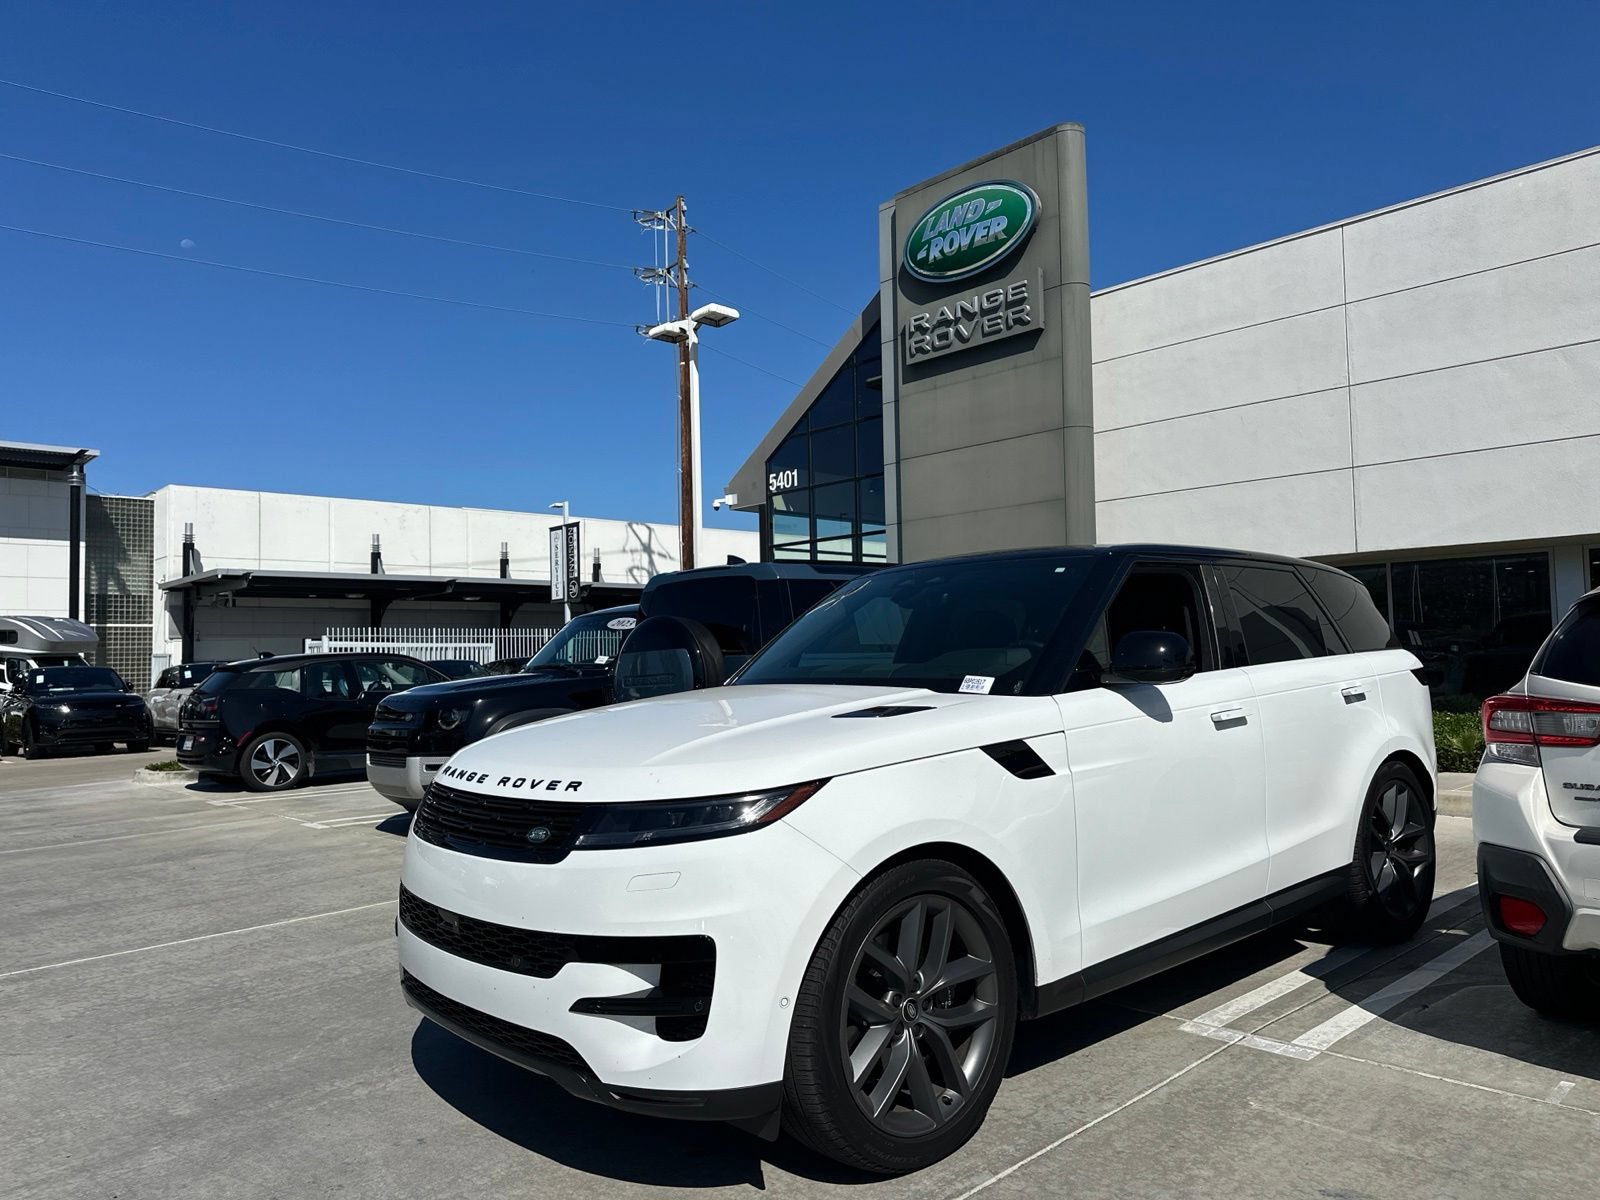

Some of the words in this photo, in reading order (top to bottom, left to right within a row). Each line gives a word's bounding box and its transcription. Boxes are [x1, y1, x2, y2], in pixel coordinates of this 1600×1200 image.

[922, 198, 986, 242] LAND
[928, 216, 1008, 264] ROVER
[910, 280, 1029, 333] RANGE
[910, 305, 1031, 356] ROVER
[769, 469, 798, 491] 5401
[442, 765, 490, 784] RANGE
[497, 776, 583, 792] ROVER
